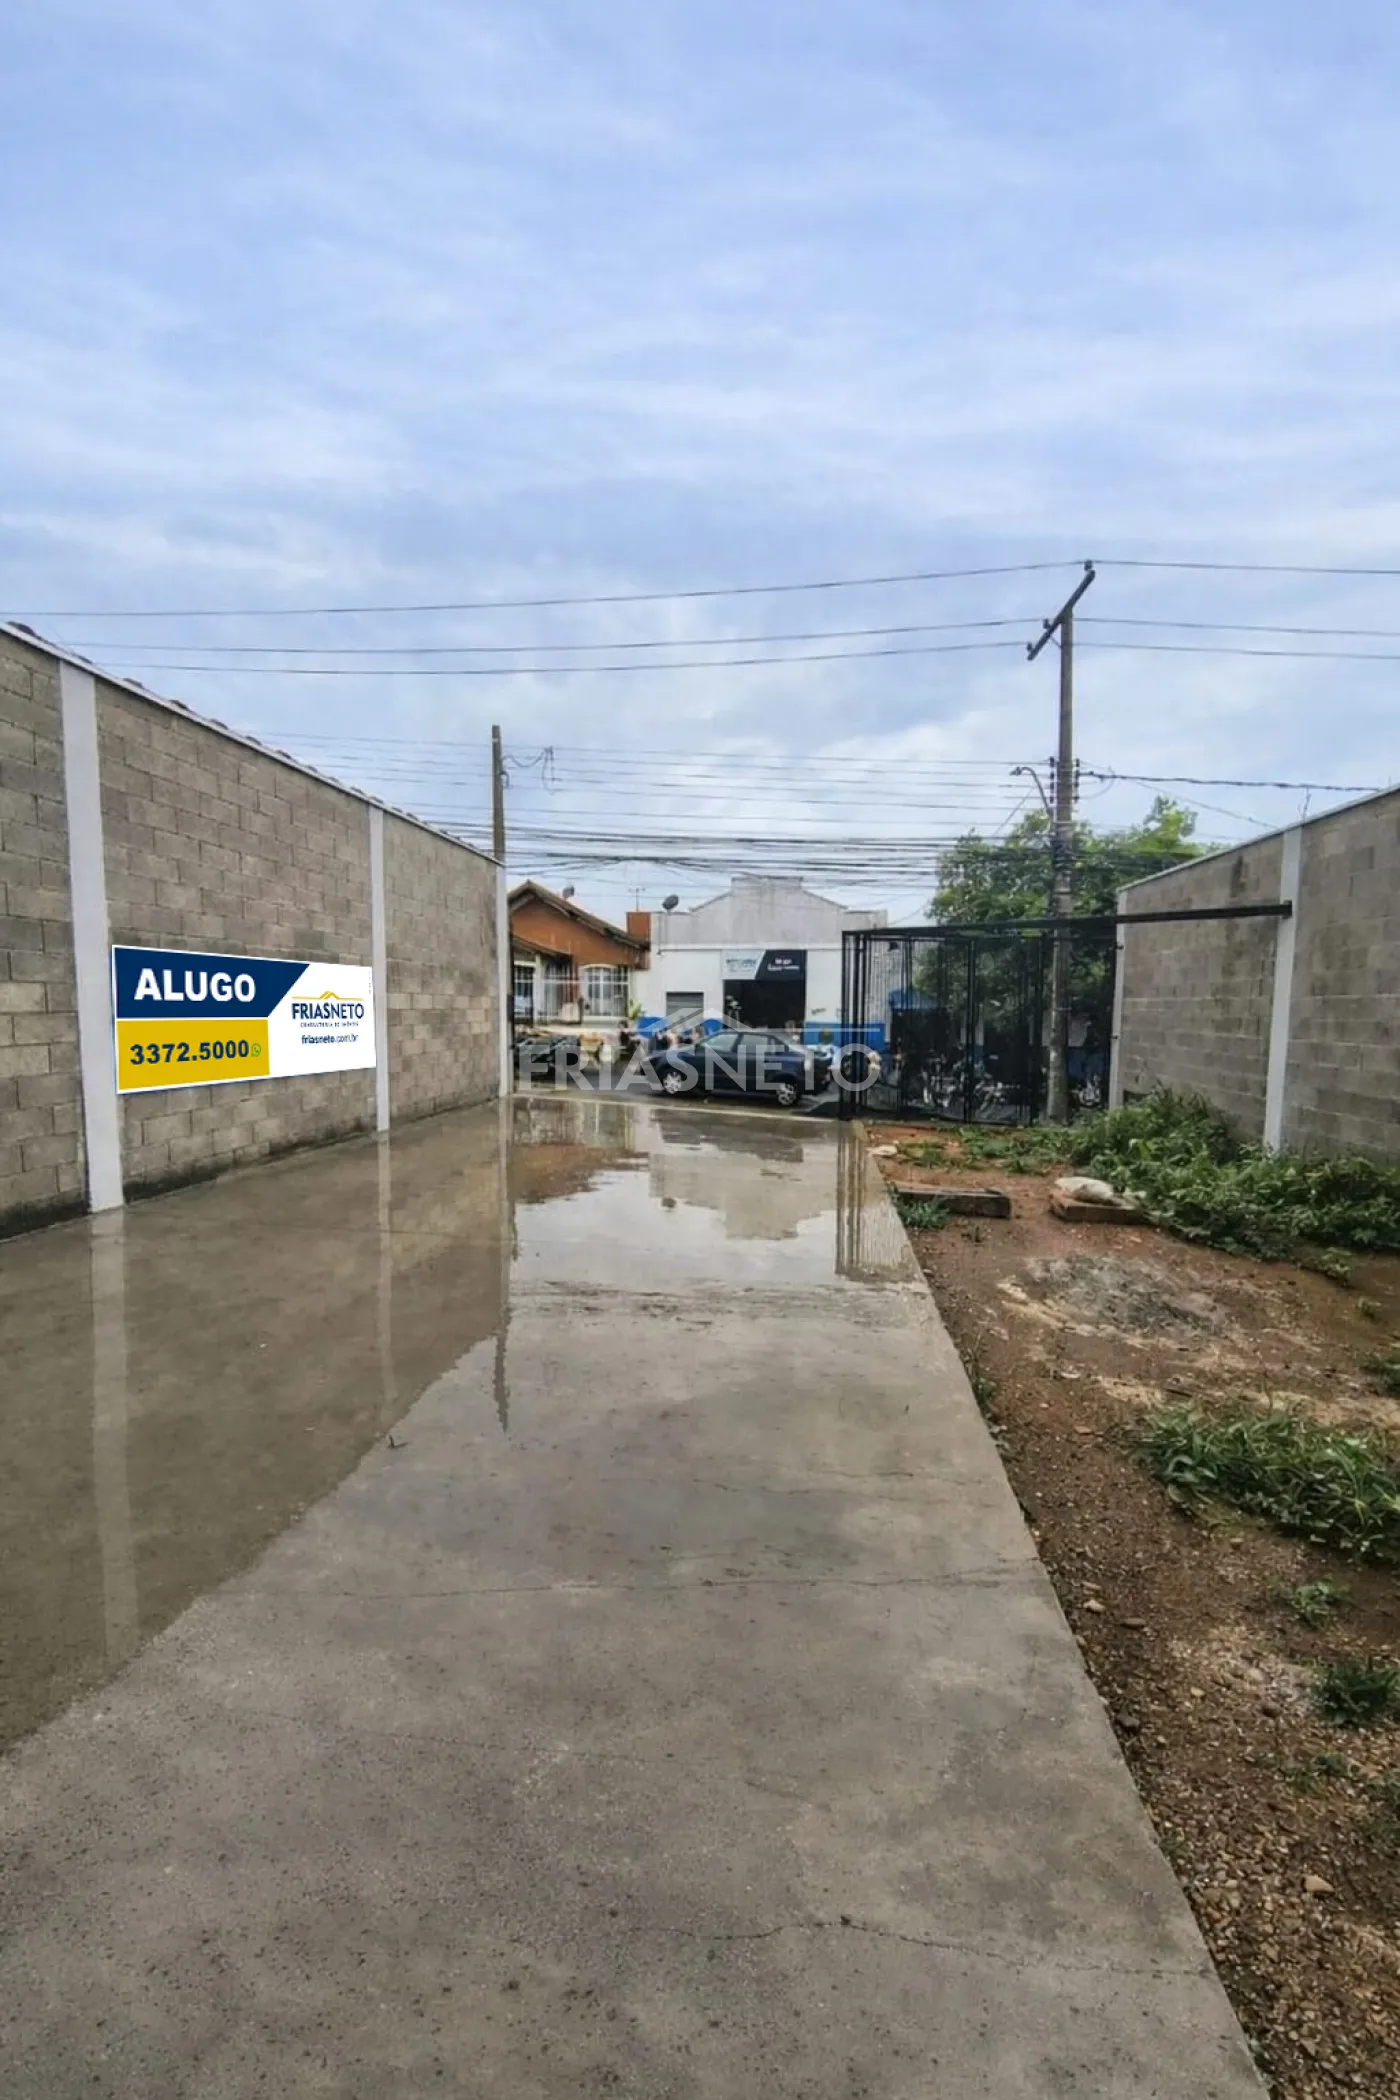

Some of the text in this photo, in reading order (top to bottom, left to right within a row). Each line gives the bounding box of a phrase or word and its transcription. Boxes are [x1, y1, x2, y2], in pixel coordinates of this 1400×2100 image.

[134, 968, 256, 1002] ALUGO
[291, 1002, 364, 1020] FRIASNETO
[301, 1033, 359, 1044] friasneto.com.br
[130, 1040, 249, 1065] 3372.5000
